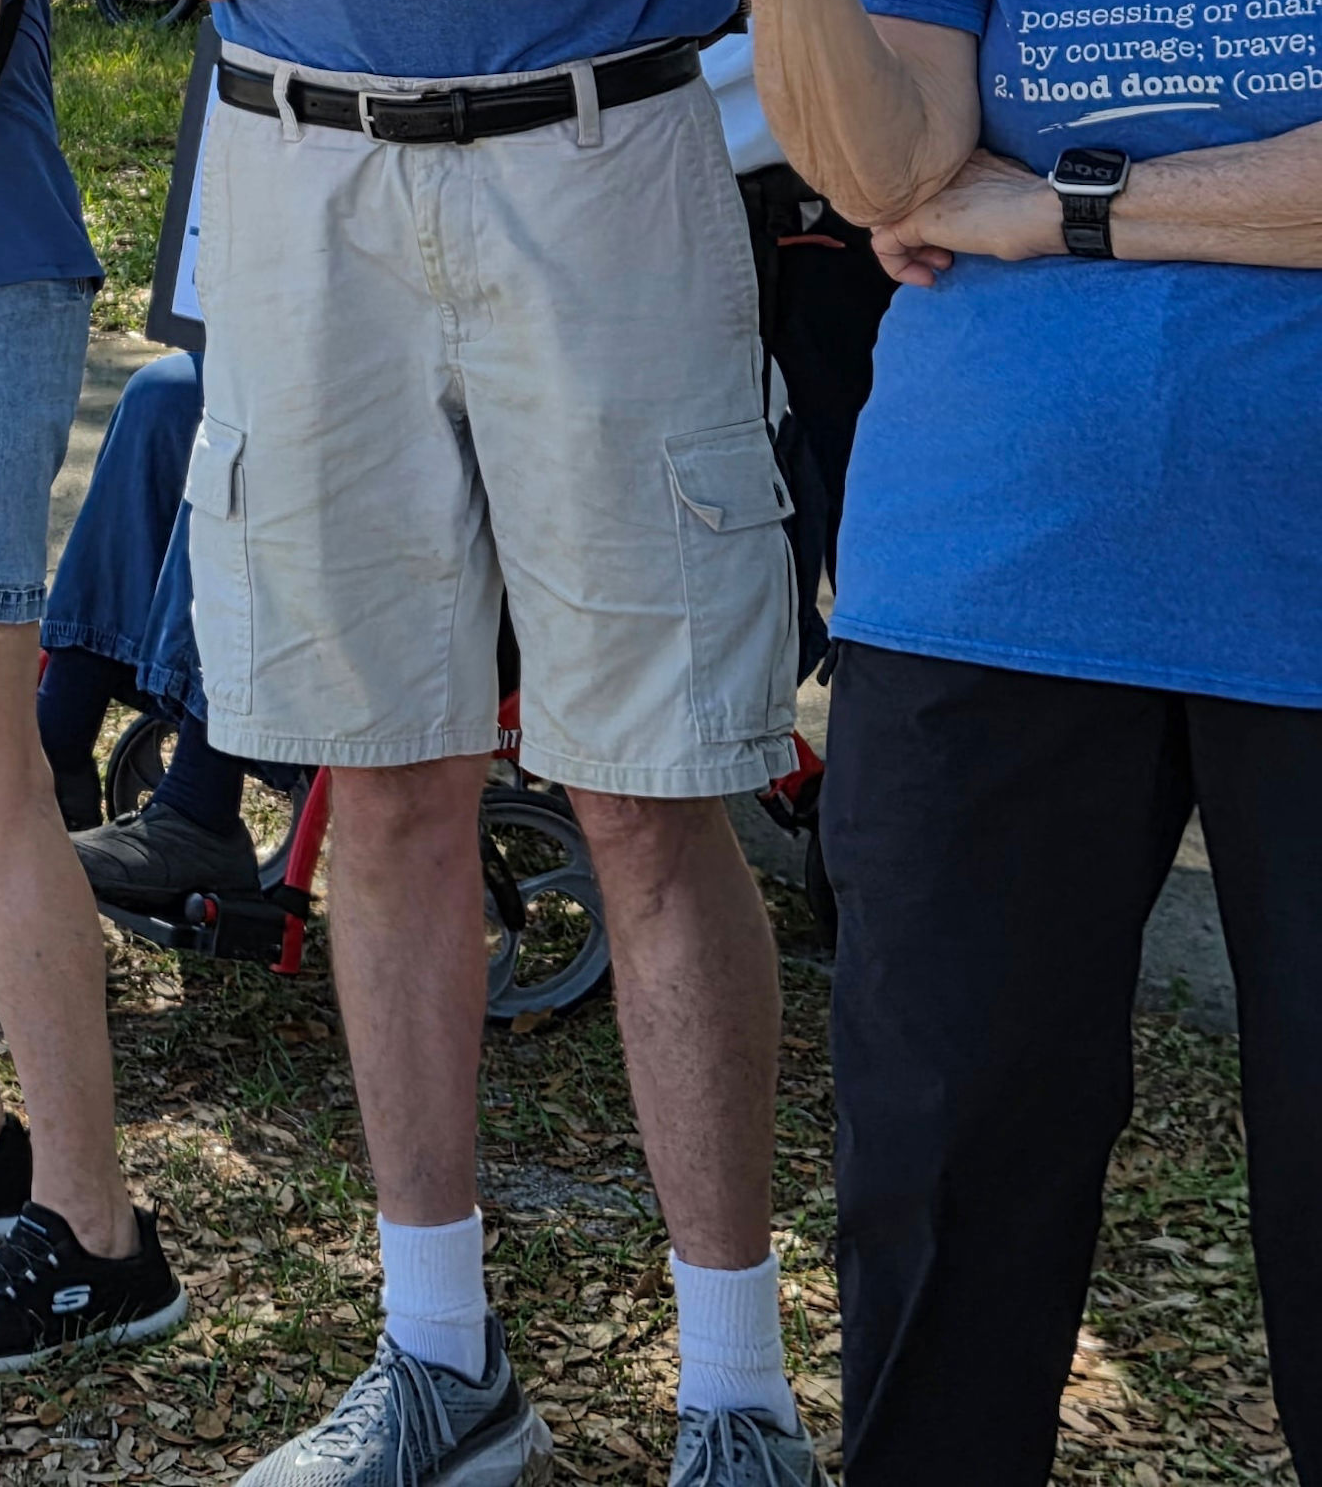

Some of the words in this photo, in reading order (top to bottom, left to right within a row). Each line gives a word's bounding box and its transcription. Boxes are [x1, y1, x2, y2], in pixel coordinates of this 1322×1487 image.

[1019, 3, 1195, 34] possessing
[1203, 3, 1237, 23] or
[1018, 41, 1057, 71] by
[1065, 38, 1204, 63] courage;
[1213, 33, 1316, 60] brave;
[994, 74, 1014, 98] 2.
[1021, 75, 1112, 102] blood
[1121, 72, 1224, 98] donor
